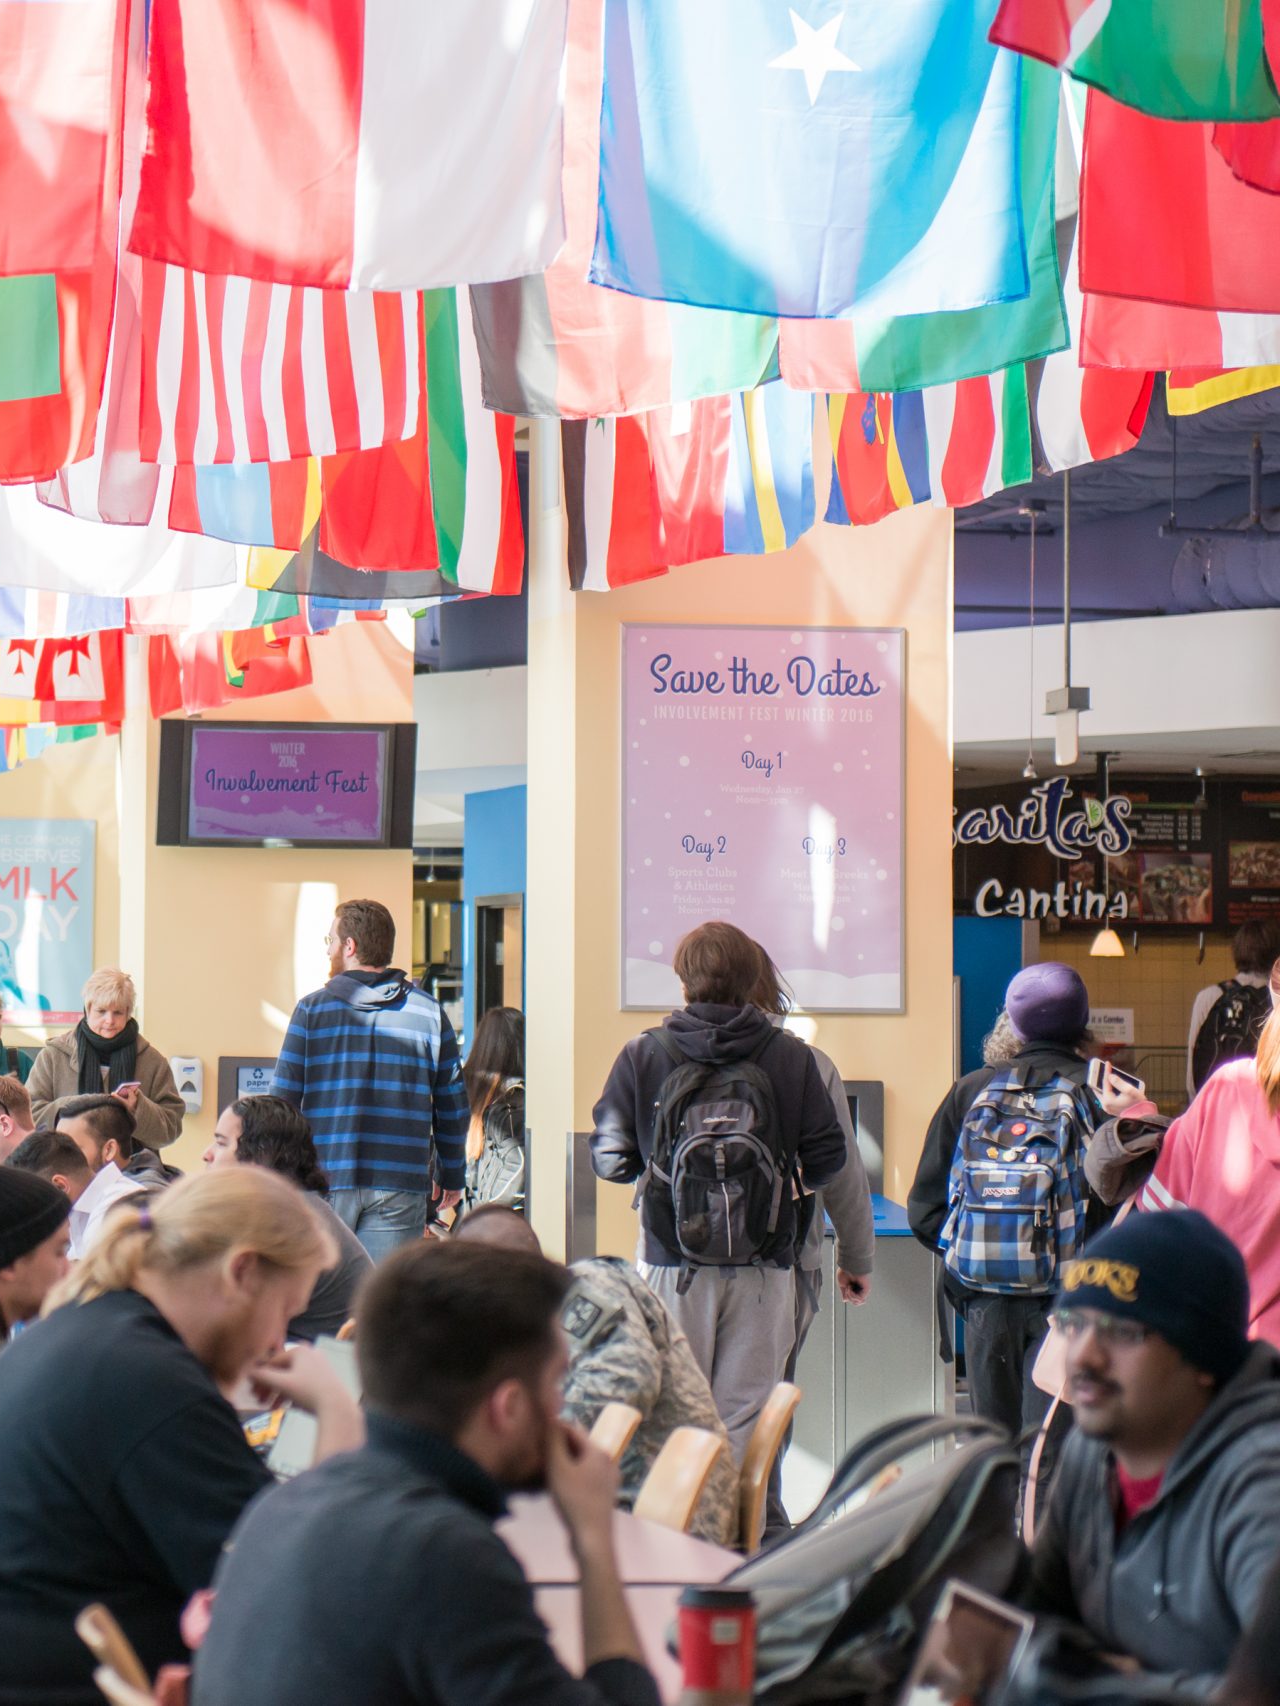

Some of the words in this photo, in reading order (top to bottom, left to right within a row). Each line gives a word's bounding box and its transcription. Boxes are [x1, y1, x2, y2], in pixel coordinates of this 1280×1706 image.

[650, 653, 725, 694] Save
[728, 656, 780, 695] the
[787, 656, 881, 697] Dates
[653, 704, 744, 721] INVOLVEMENT
[749, 706, 779, 721] FEST
[785, 707, 834, 722] WINTER
[840, 708, 873, 723] 2016
[270, 742, 306, 755] WINTER
[277, 755, 297, 768] 2016
[741, 750, 774, 778] Day
[776, 752, 783, 769] 1
[205, 768, 321, 792] Involvement
[325, 769, 369, 793] Fest
[682, 834, 715, 863] Day
[717, 835, 726, 854] 2
[801, 836, 834, 864] Day
[837, 837, 846, 855] 3
[667, 866, 704, 880] Sports
[705, 865, 738, 878] Clubs
[685, 880, 736, 892] Athletics
[976, 877, 1129, 920] Cantina
[246, 1080, 270, 1088] paper
